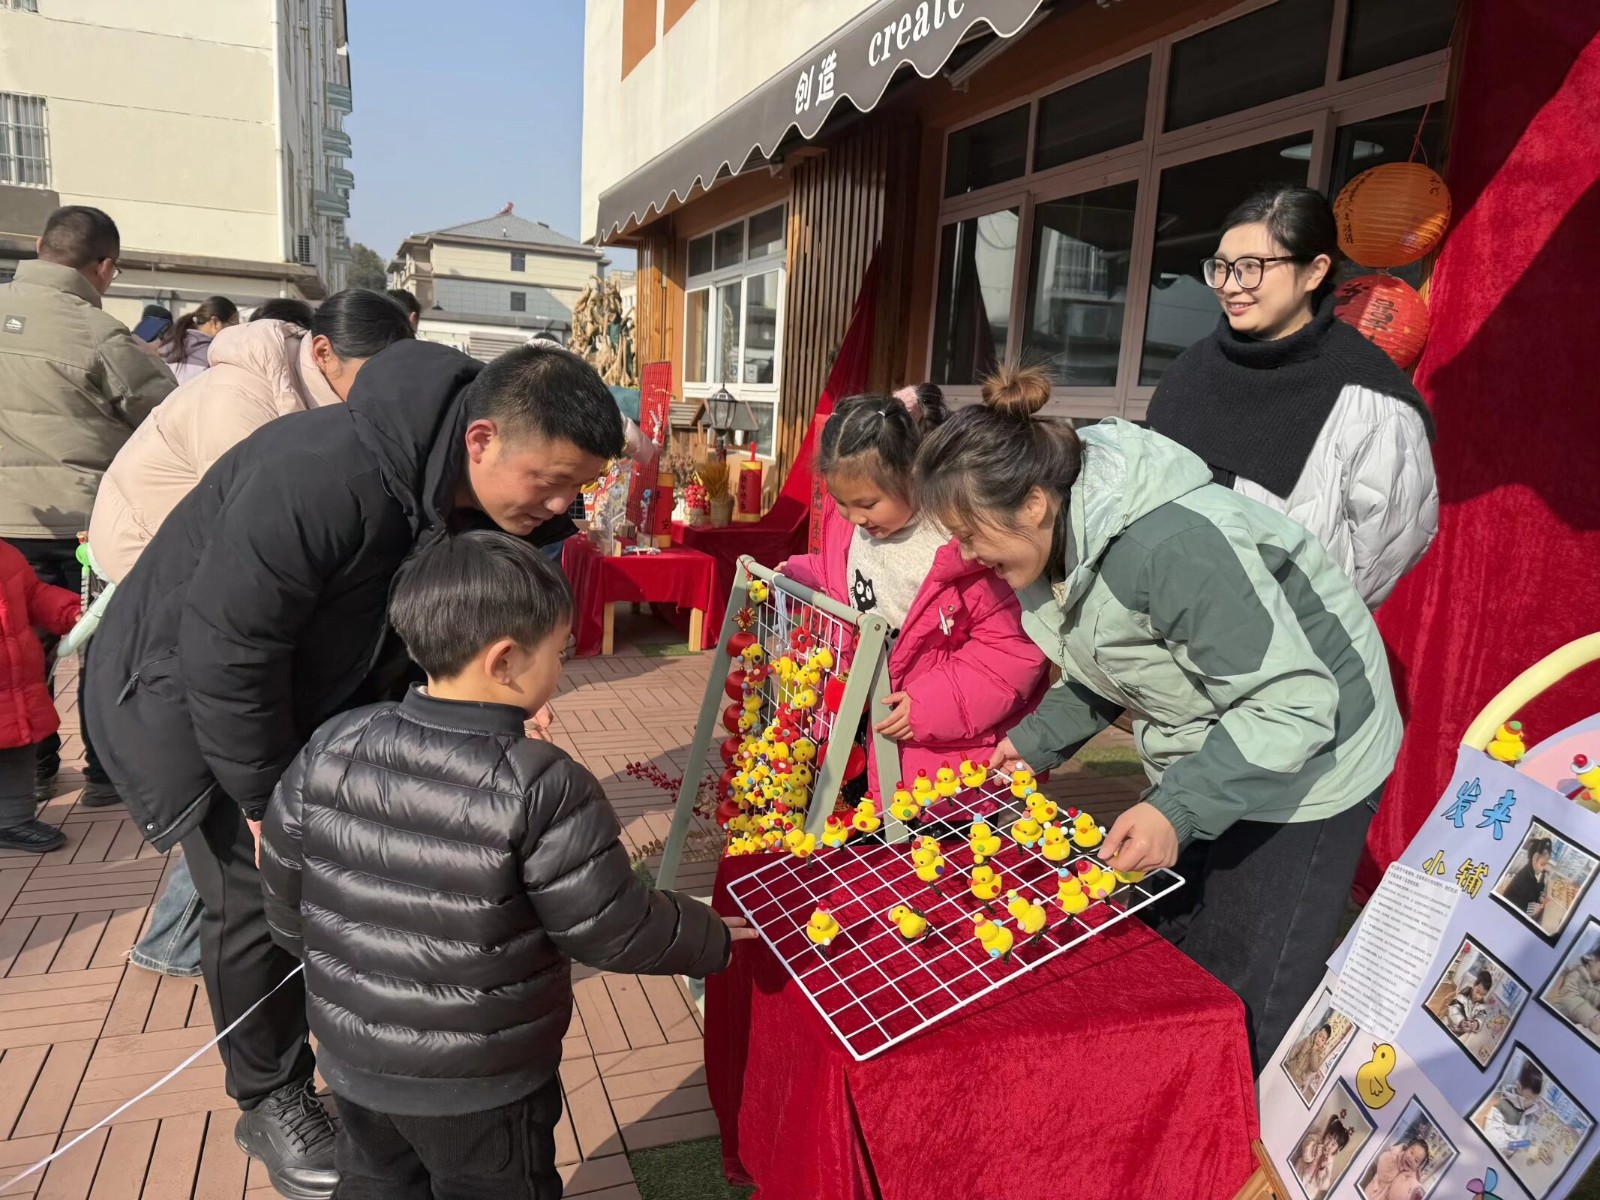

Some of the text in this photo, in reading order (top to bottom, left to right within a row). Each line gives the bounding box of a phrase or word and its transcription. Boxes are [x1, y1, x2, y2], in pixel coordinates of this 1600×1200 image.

[795, 50, 837, 115] 创造
[1441, 777, 1516, 840] 发夹
[1422, 850, 1489, 899] 小铺
